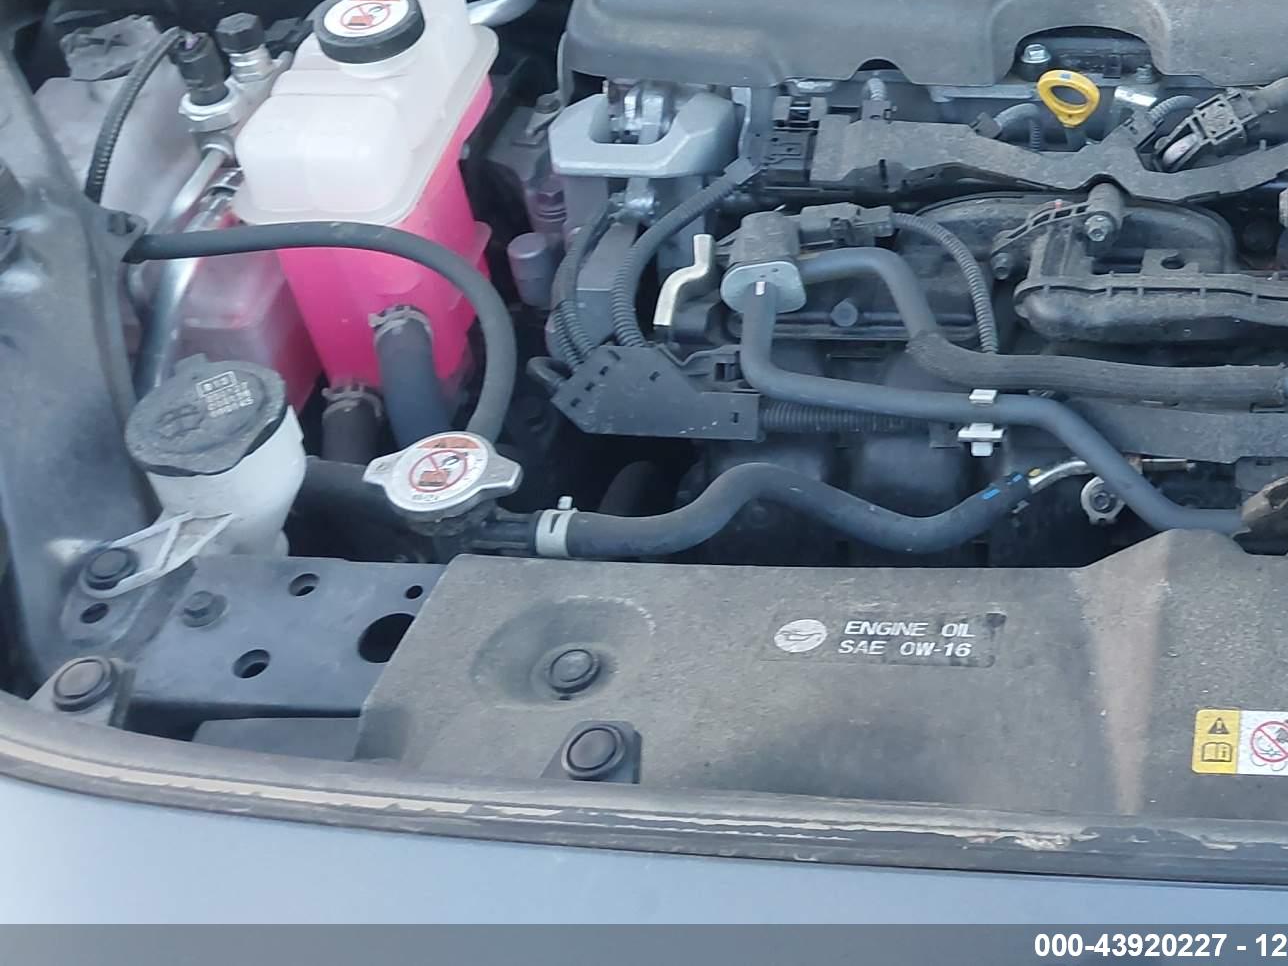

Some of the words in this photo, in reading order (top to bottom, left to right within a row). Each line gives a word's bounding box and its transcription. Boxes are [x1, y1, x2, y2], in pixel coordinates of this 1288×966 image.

[844, 621, 928, 637] ENGINE
[941, 623, 976, 638] OIL
[838, 640, 887, 655] SAE
[900, 641, 972, 657] 0W-16
